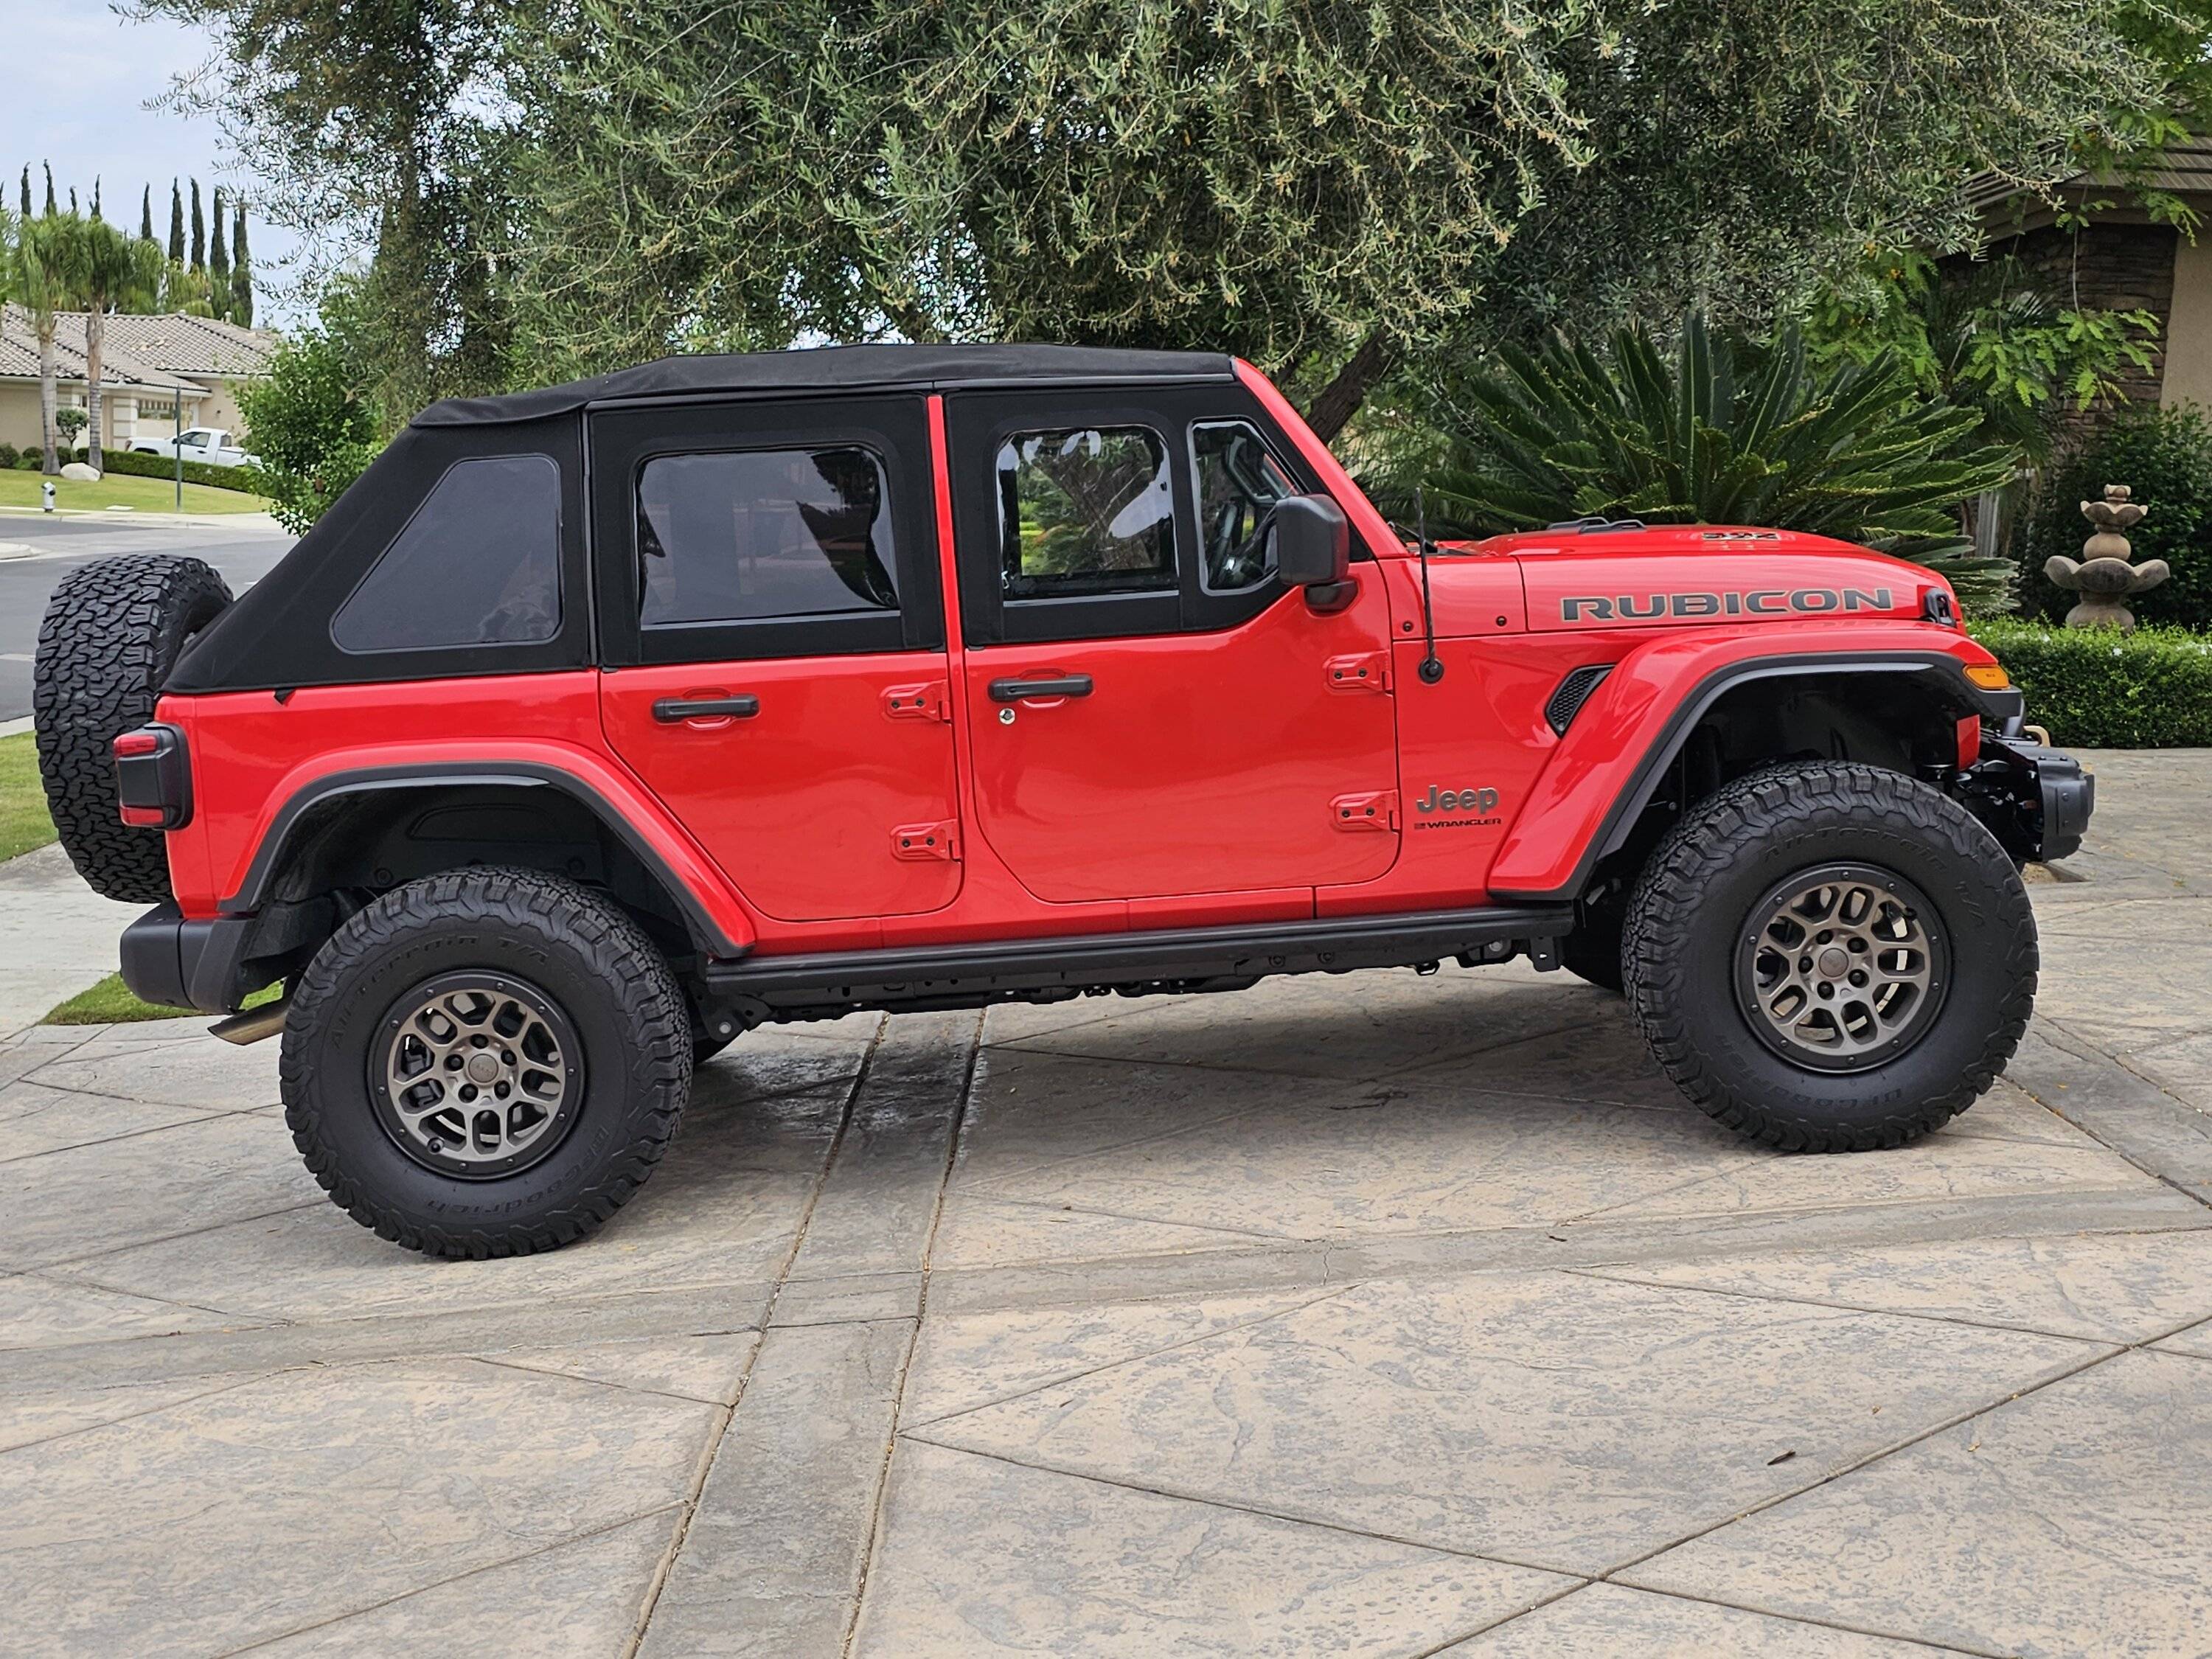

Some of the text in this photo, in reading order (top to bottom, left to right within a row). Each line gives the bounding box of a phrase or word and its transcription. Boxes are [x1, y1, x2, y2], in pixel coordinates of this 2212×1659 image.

[1561, 587, 1893, 622] RUBICON
[1416, 785, 1499, 815] Jeep
[1427, 818, 1502, 830] WRANGLER
